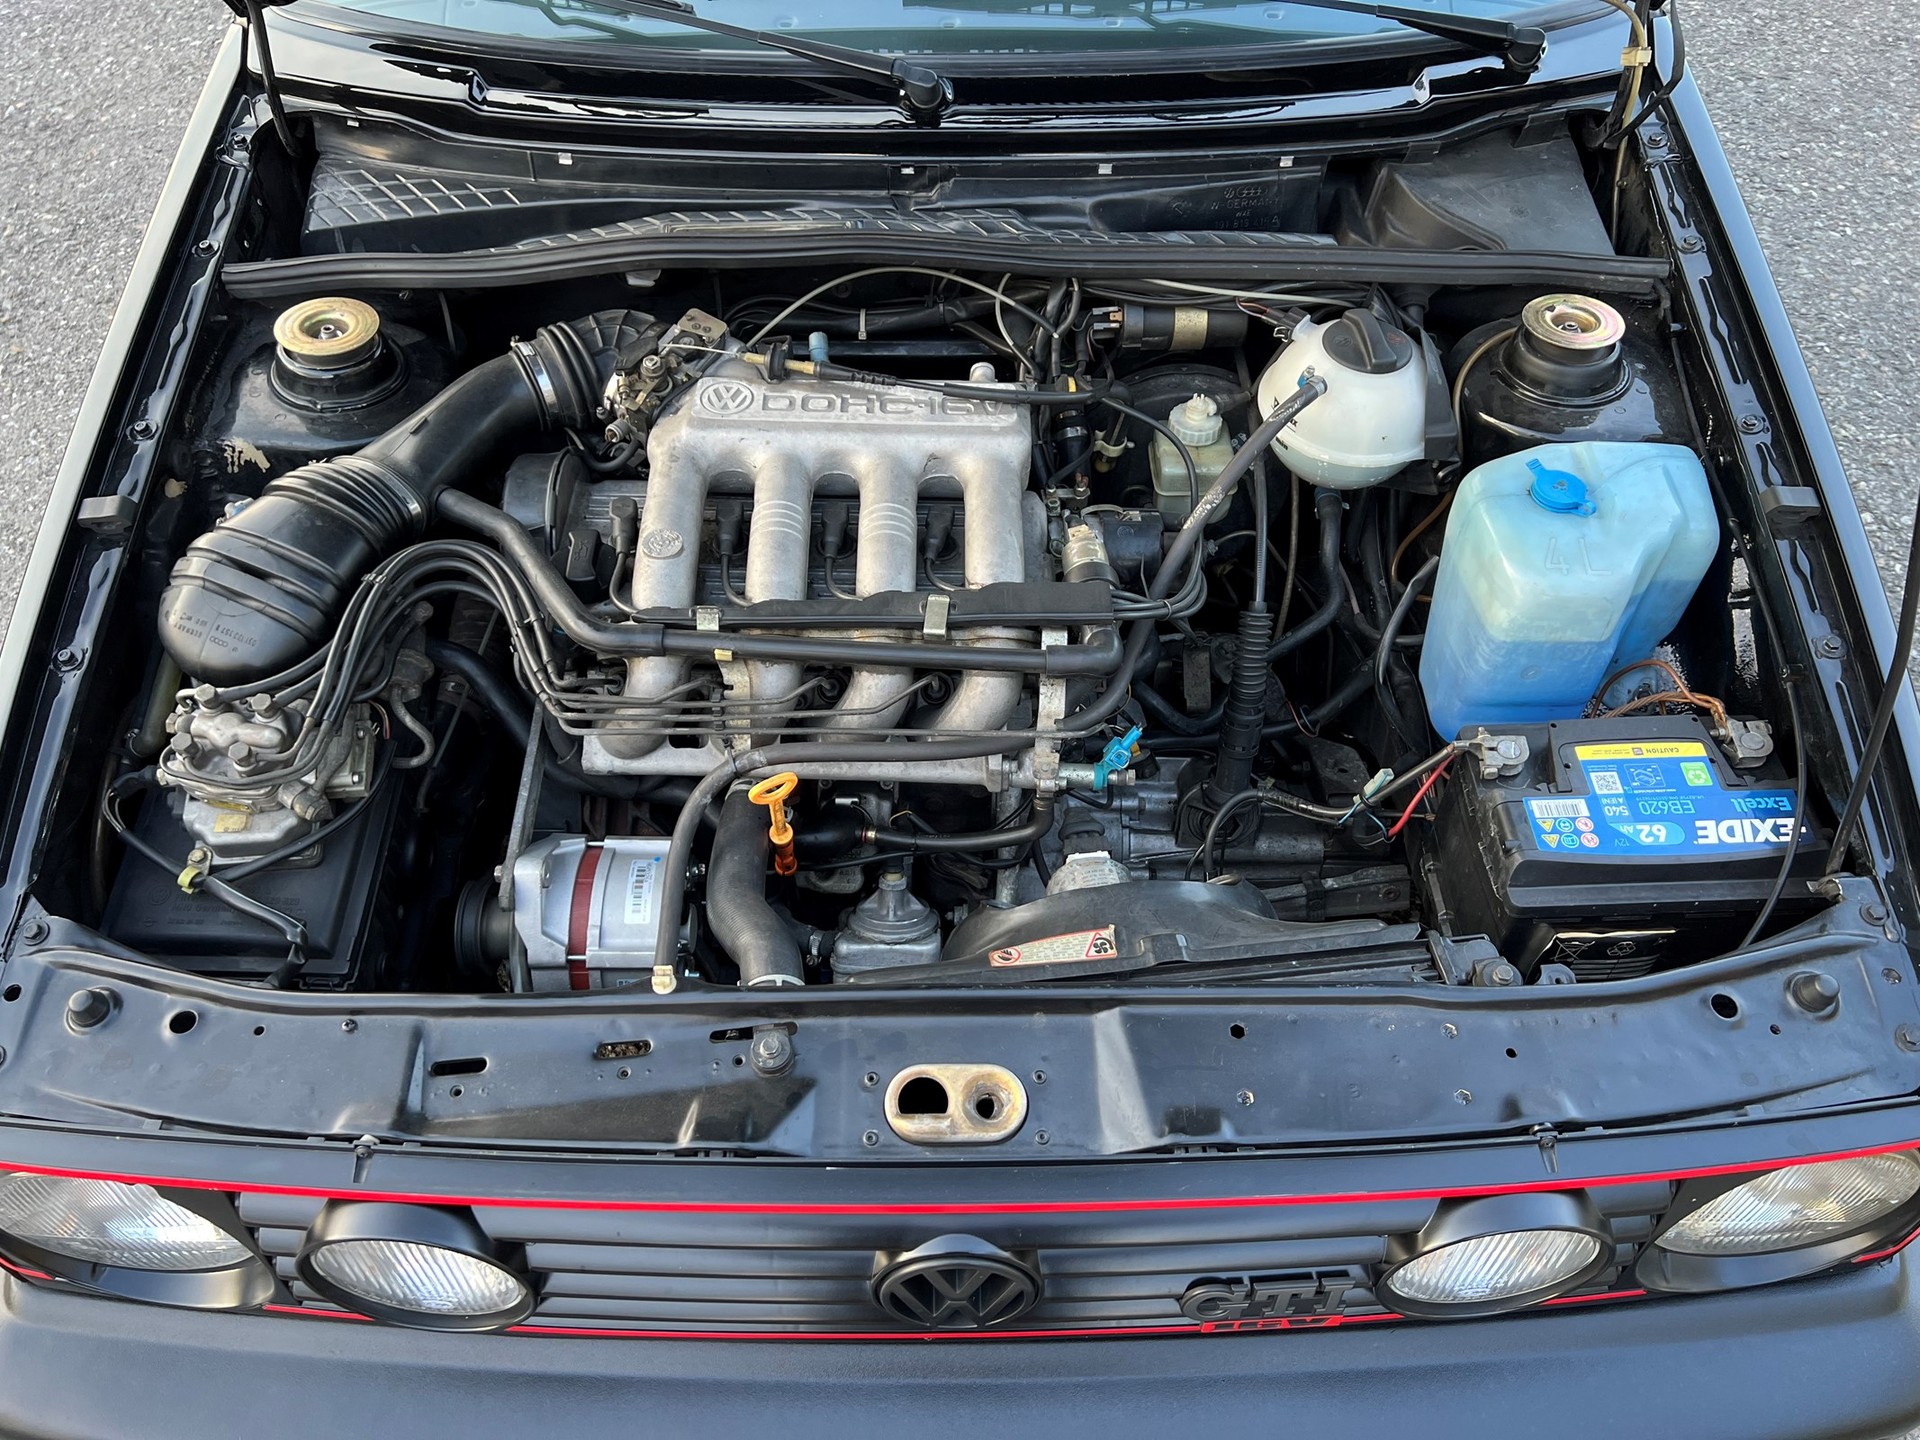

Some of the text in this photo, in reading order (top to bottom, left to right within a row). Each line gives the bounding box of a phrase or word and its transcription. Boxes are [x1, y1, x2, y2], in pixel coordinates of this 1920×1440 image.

[1645, 746, 1680, 756] CAUTION
[1604, 805, 1629, 816] 540
[1638, 800, 1696, 815] EB620
[1730, 797, 1793, 813] Excell
[1619, 823, 1667, 843] 62 Ah
[1694, 817, 1797, 845] EXIDE
[1614, 838, 1630, 847] 12V
[1180, 1276, 1357, 1322] GTI
